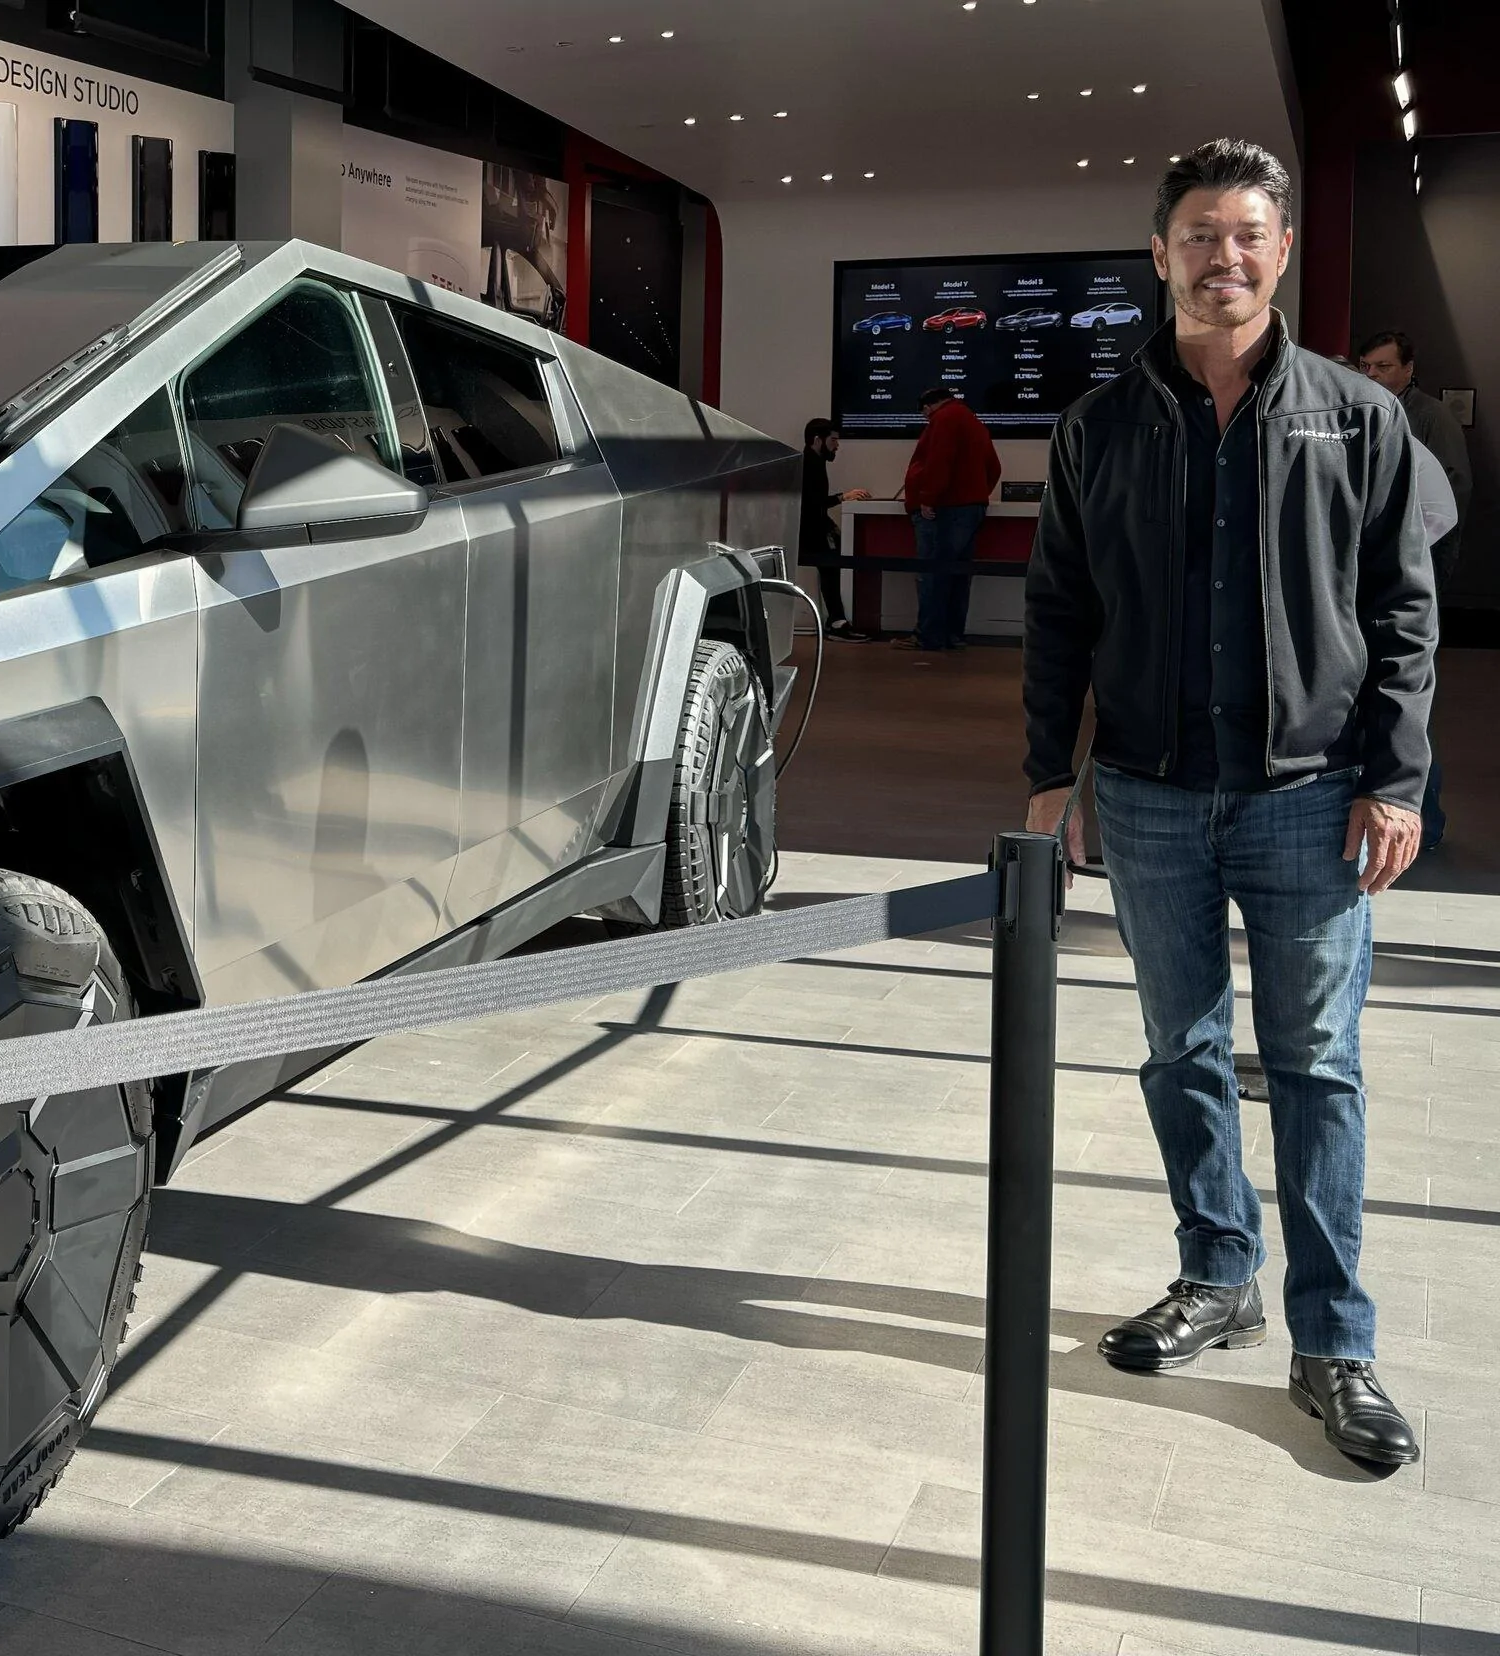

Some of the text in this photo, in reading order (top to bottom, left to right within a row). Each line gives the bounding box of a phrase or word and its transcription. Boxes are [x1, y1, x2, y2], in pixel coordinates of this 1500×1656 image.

[73, 76, 140, 115] STUDIO
[348, 162, 392, 187] Anywhere
[1287, 428, 1350, 440] McLaren
